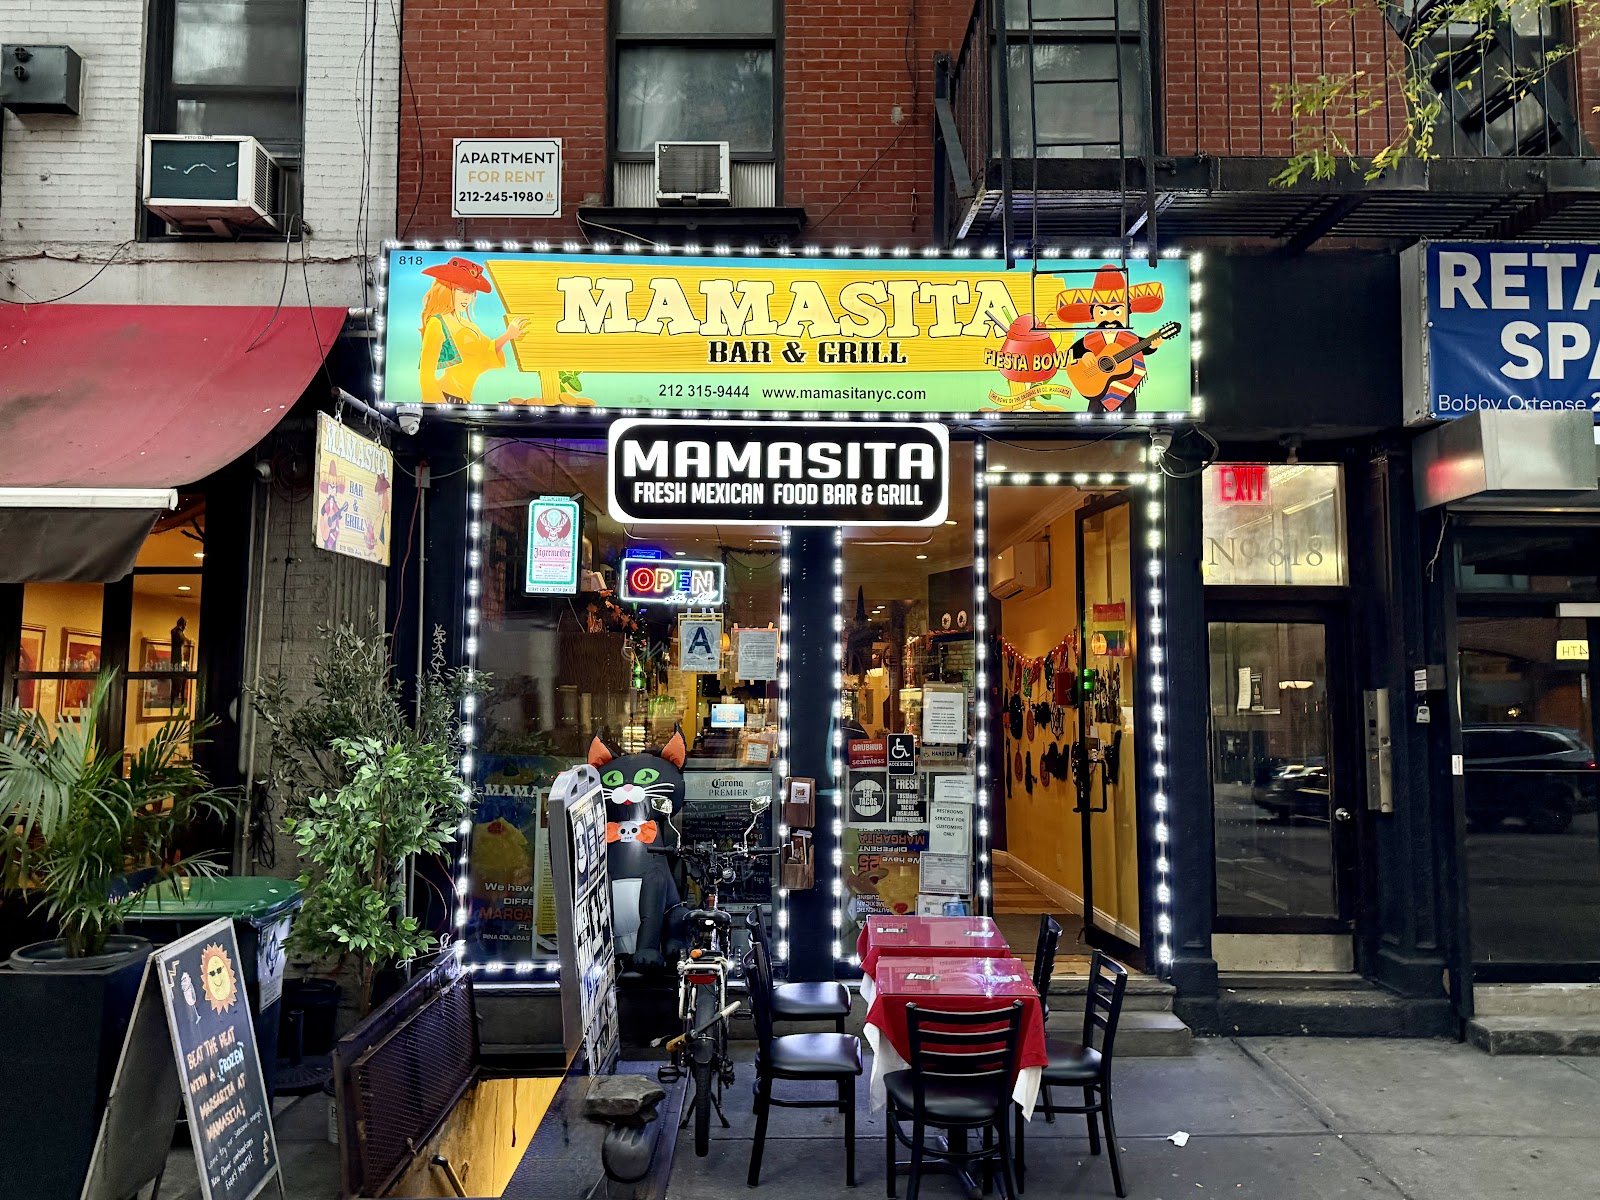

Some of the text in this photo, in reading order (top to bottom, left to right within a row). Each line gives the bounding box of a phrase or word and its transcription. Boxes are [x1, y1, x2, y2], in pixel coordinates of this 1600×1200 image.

[460, 152, 555, 164] APARTMENT
[468, 171, 545, 182] FOR RENT
[459, 191, 544, 202] 212-245-1980
[398, 256, 424, 266] 818
[556, 275, 1019, 339] MAMASITA
[709, 341, 909, 365] BAR & GRILL
[1499, 320, 1600, 380] SP
[984, 348, 1078, 371] FIESTA BOWL
[659, 384, 926, 401] 212 315-9444 www.mamasitanyc.com
[1438, 394, 1502, 411] Bobby
[1507, 395, 1587, 411] Ortense
[324, 419, 389, 480] MAMASITA
[623, 439, 935, 480] MAMASITA
[349, 481, 364, 498] BAR
[634, 481, 923, 506] FRESH MEXICAN FOOD BAR & GRILL
[1219, 467, 1266, 502] EXIT
[353, 499, 359, 513] &
[344, 513, 365, 532] GRILL
[1267, 537, 1323, 567] 818
[631, 567, 714, 595] OPEN
[688, 626, 712, 654] A
[852, 743, 883, 752] GRUBHUB
[712, 778, 744, 788] Corona
[896, 779, 920, 790] FRESH
[858, 798, 878, 806] TACOS
[863, 790, 873, 798] EAT
[858, 833, 925, 846] MARGARITA
[858, 854, 880, 872] 25
[484, 882, 504, 891] We
[187, 1026, 236, 1070] BEAT THE HEAT
[190, 1047, 244, 1094] WITH A FROZEN
[199, 1072, 246, 1120] MARGARITA AT
[206, 1098, 246, 1142] MAMASITA!
